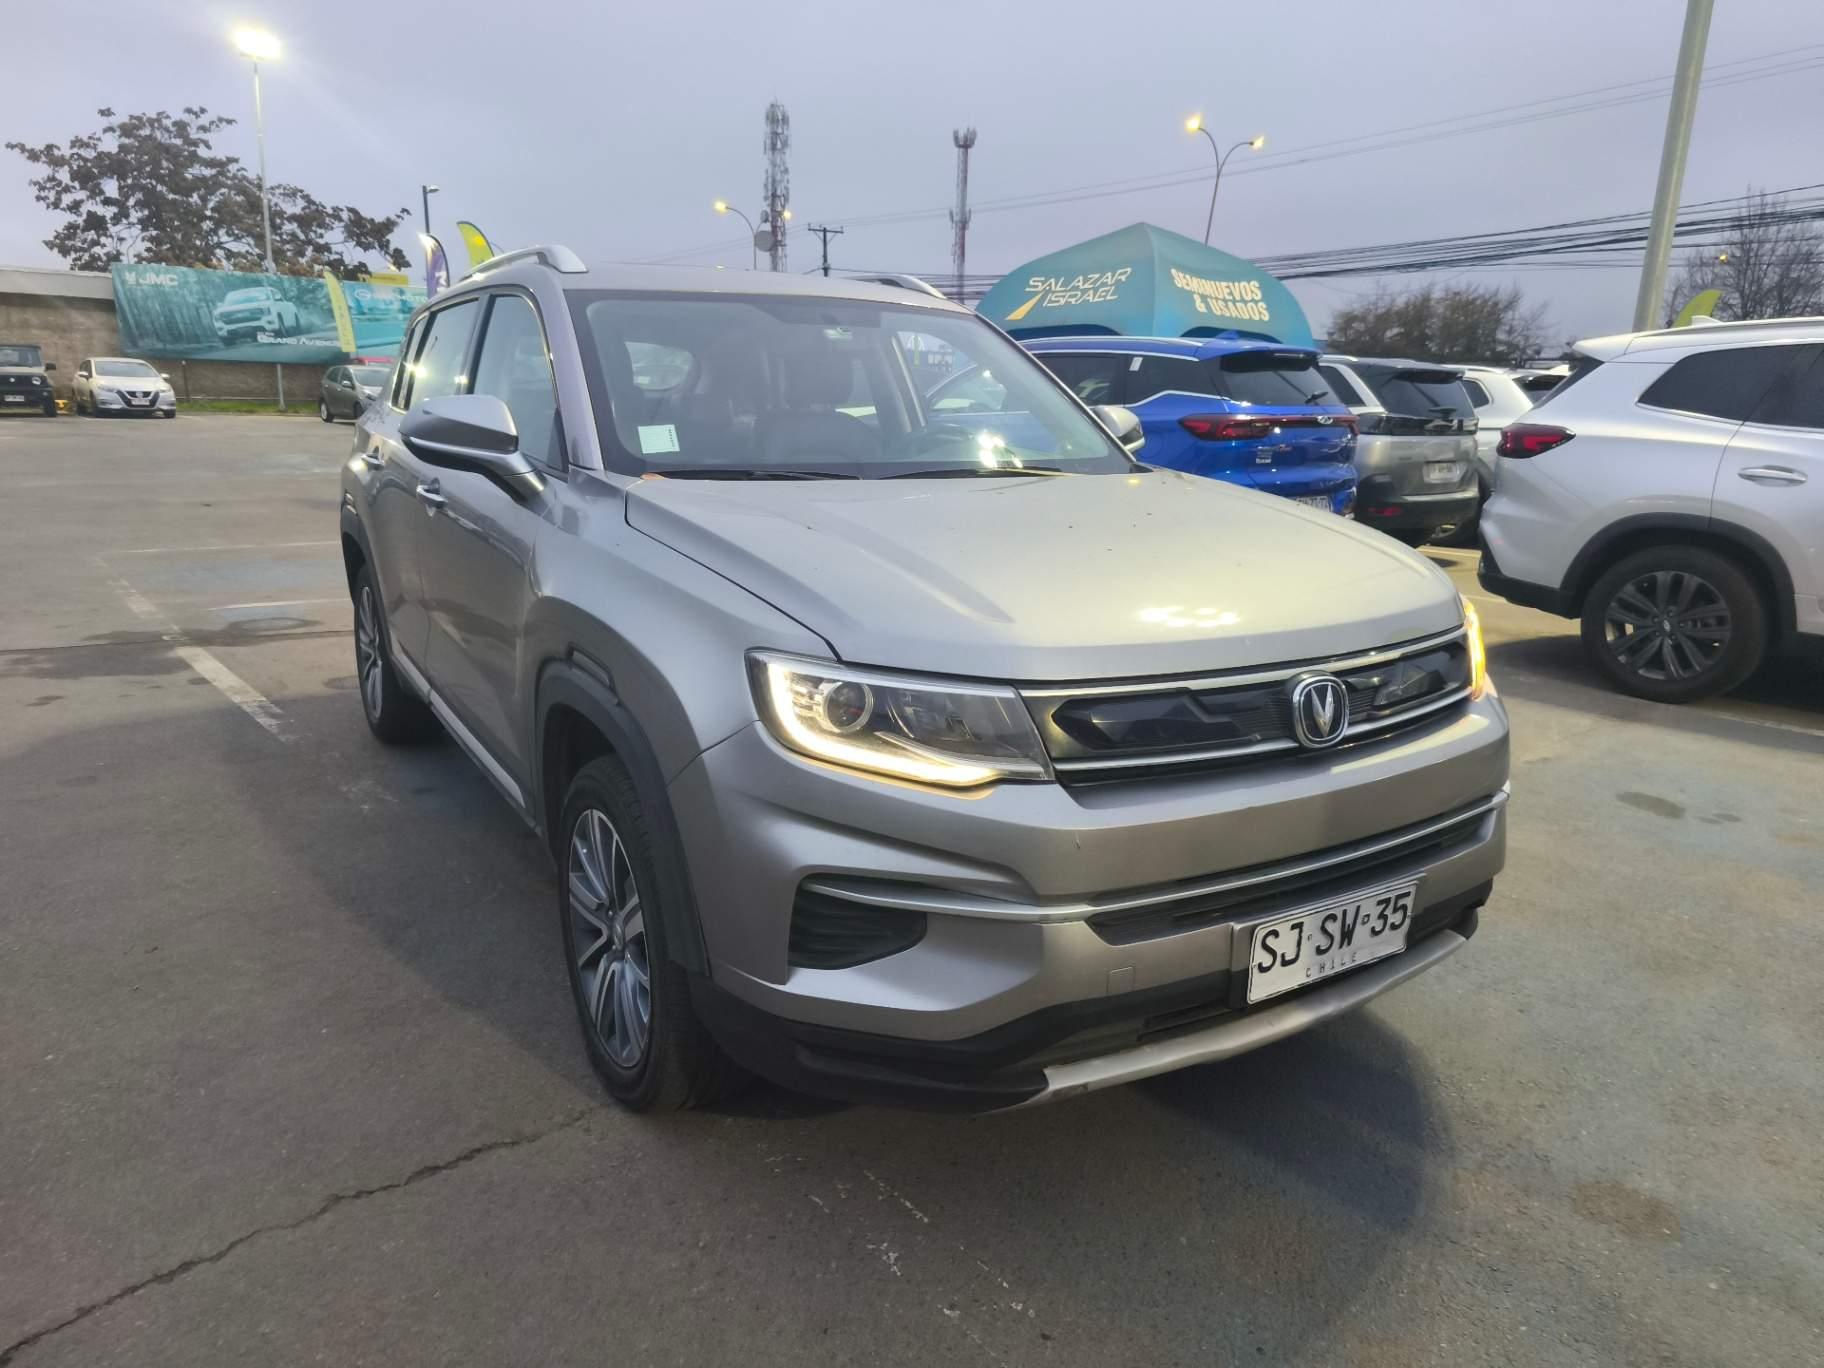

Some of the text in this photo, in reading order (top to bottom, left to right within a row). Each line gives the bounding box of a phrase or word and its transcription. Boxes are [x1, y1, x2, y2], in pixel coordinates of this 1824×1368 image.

[139, 272, 178, 286] JMC
[1025, 267, 1132, 292] SALAZAR
[1170, 268, 1262, 301] SEMINUEVOS
[1042, 286, 1118, 307] ISRAEL
[1193, 293, 1270, 322] & USADOS
[1304, 951, 1358, 978] CHILE
